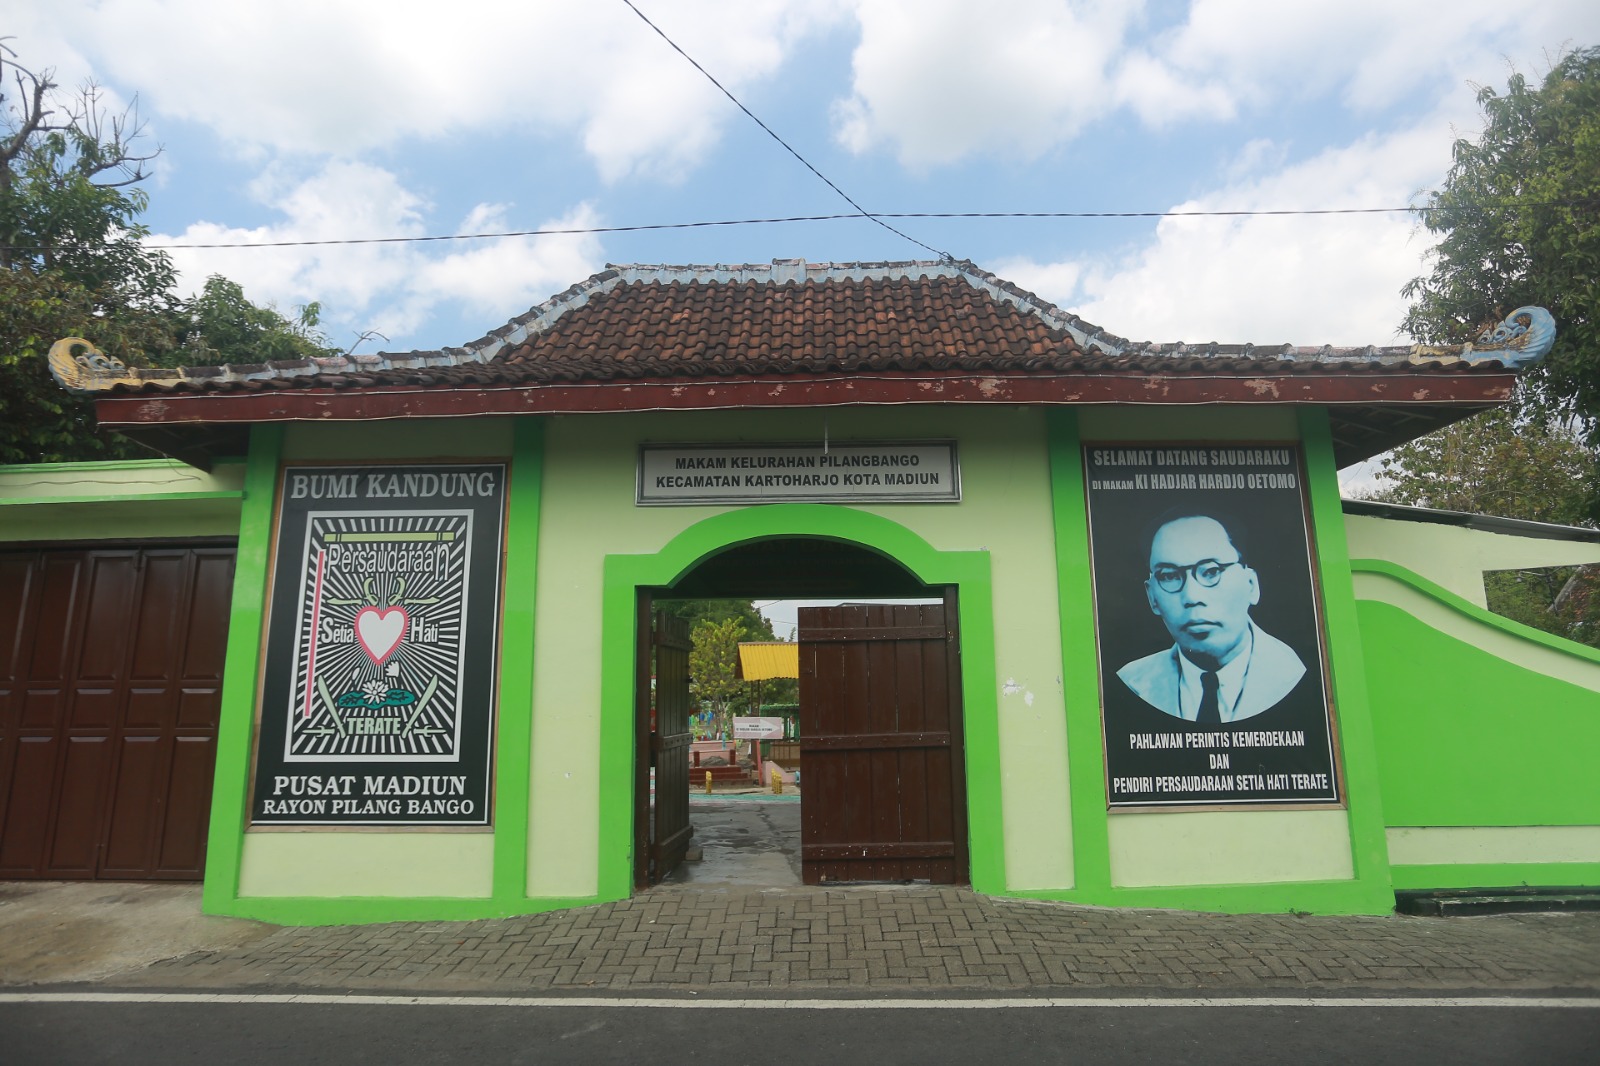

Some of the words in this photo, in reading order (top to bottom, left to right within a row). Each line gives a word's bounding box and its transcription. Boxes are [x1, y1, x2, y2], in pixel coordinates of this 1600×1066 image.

[675, 456, 727, 469] MAKAM
[730, 455, 816, 468] KELURAHAN
[819, 454, 920, 467] PILANGBANGO
[1094, 450, 1153, 466] SELAMAT
[1156, 450, 1208, 466] DATANG
[1210, 449, 1290, 465] SAUDARAKU
[291, 474, 359, 499] BUMI
[365, 471, 496, 498] KANDUNG
[656, 475, 741, 488] KECAMATAN
[744, 474, 839, 487] KARTOHARJO
[843, 473, 881, 485] KOTA
[884, 472, 940, 485] MADIUN
[1092, 480, 1102, 490] DI
[1103, 480, 1134, 490] MAKAM
[1135, 474, 1149, 490] KI
[1151, 474, 1197, 489] HADJAR
[1199, 474, 1245, 489] HARDJO
[1247, 473, 1296, 489] OETOMO
[326, 543, 450, 581] Persaudaraan
[320, 617, 355, 644] Setia
[410, 617, 439, 643] Hati
[346, 717, 402, 735] TERATE
[1129, 732, 1183, 750] PAHLAWAN
[1185, 732, 1230, 748] PERINTIS
[1232, 731, 1305, 748] KEMERDEKAAN
[1209, 753, 1230, 770] DAN
[272, 776, 356, 796] PUSAT
[363, 776, 467, 796] MADIUN
[1113, 777, 1153, 794] PENDIRI
[1155, 775, 1234, 793] PERSAUDARAAN
[1236, 775, 1265, 791] SETIA
[1267, 774, 1289, 790] HATI
[1290, 773, 1329, 790] TERATE
[263, 799, 327, 815] RAYON
[331, 799, 402, 815] PILANG
[406, 799, 474, 815] BANGO
